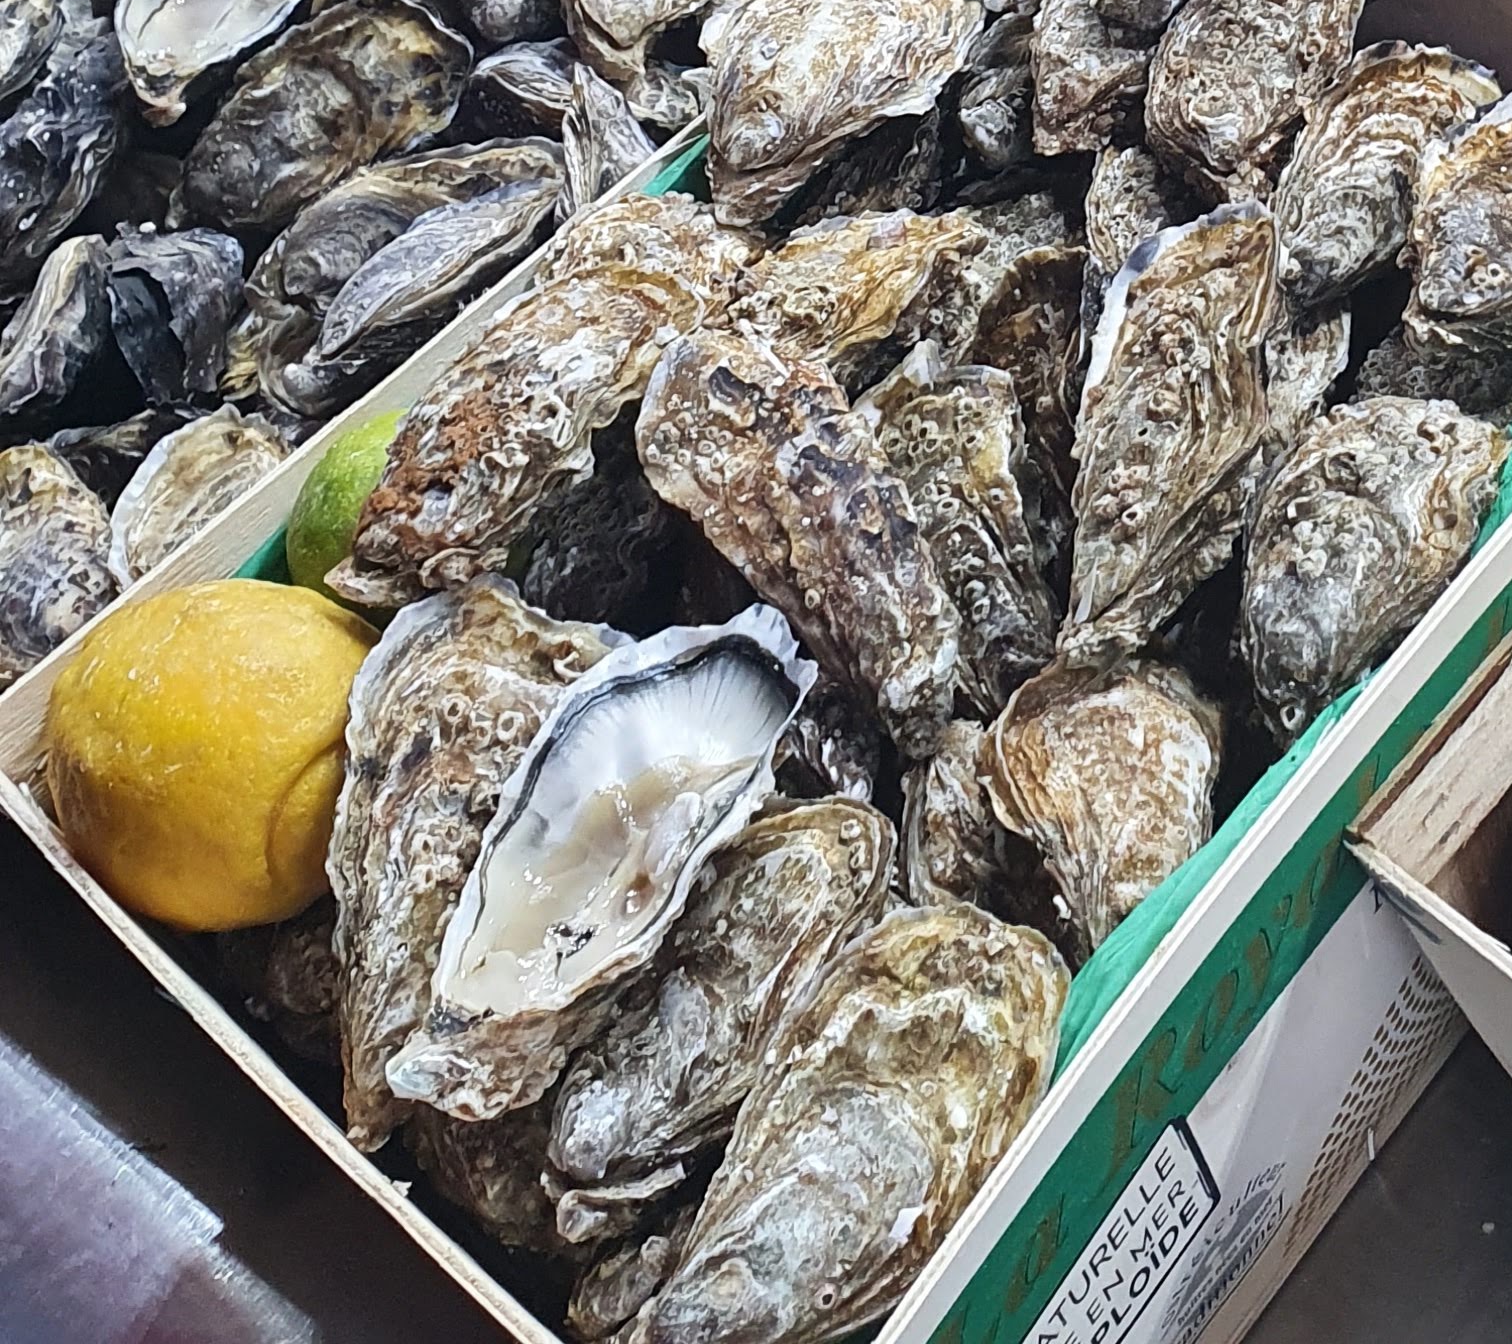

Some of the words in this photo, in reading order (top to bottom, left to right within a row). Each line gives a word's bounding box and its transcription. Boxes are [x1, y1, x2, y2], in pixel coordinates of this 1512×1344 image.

[1036, 1146, 1178, 1344] ATURELLE
[1085, 1268, 1125, 1326] EN
[1129, 1176, 1189, 1264] MER
